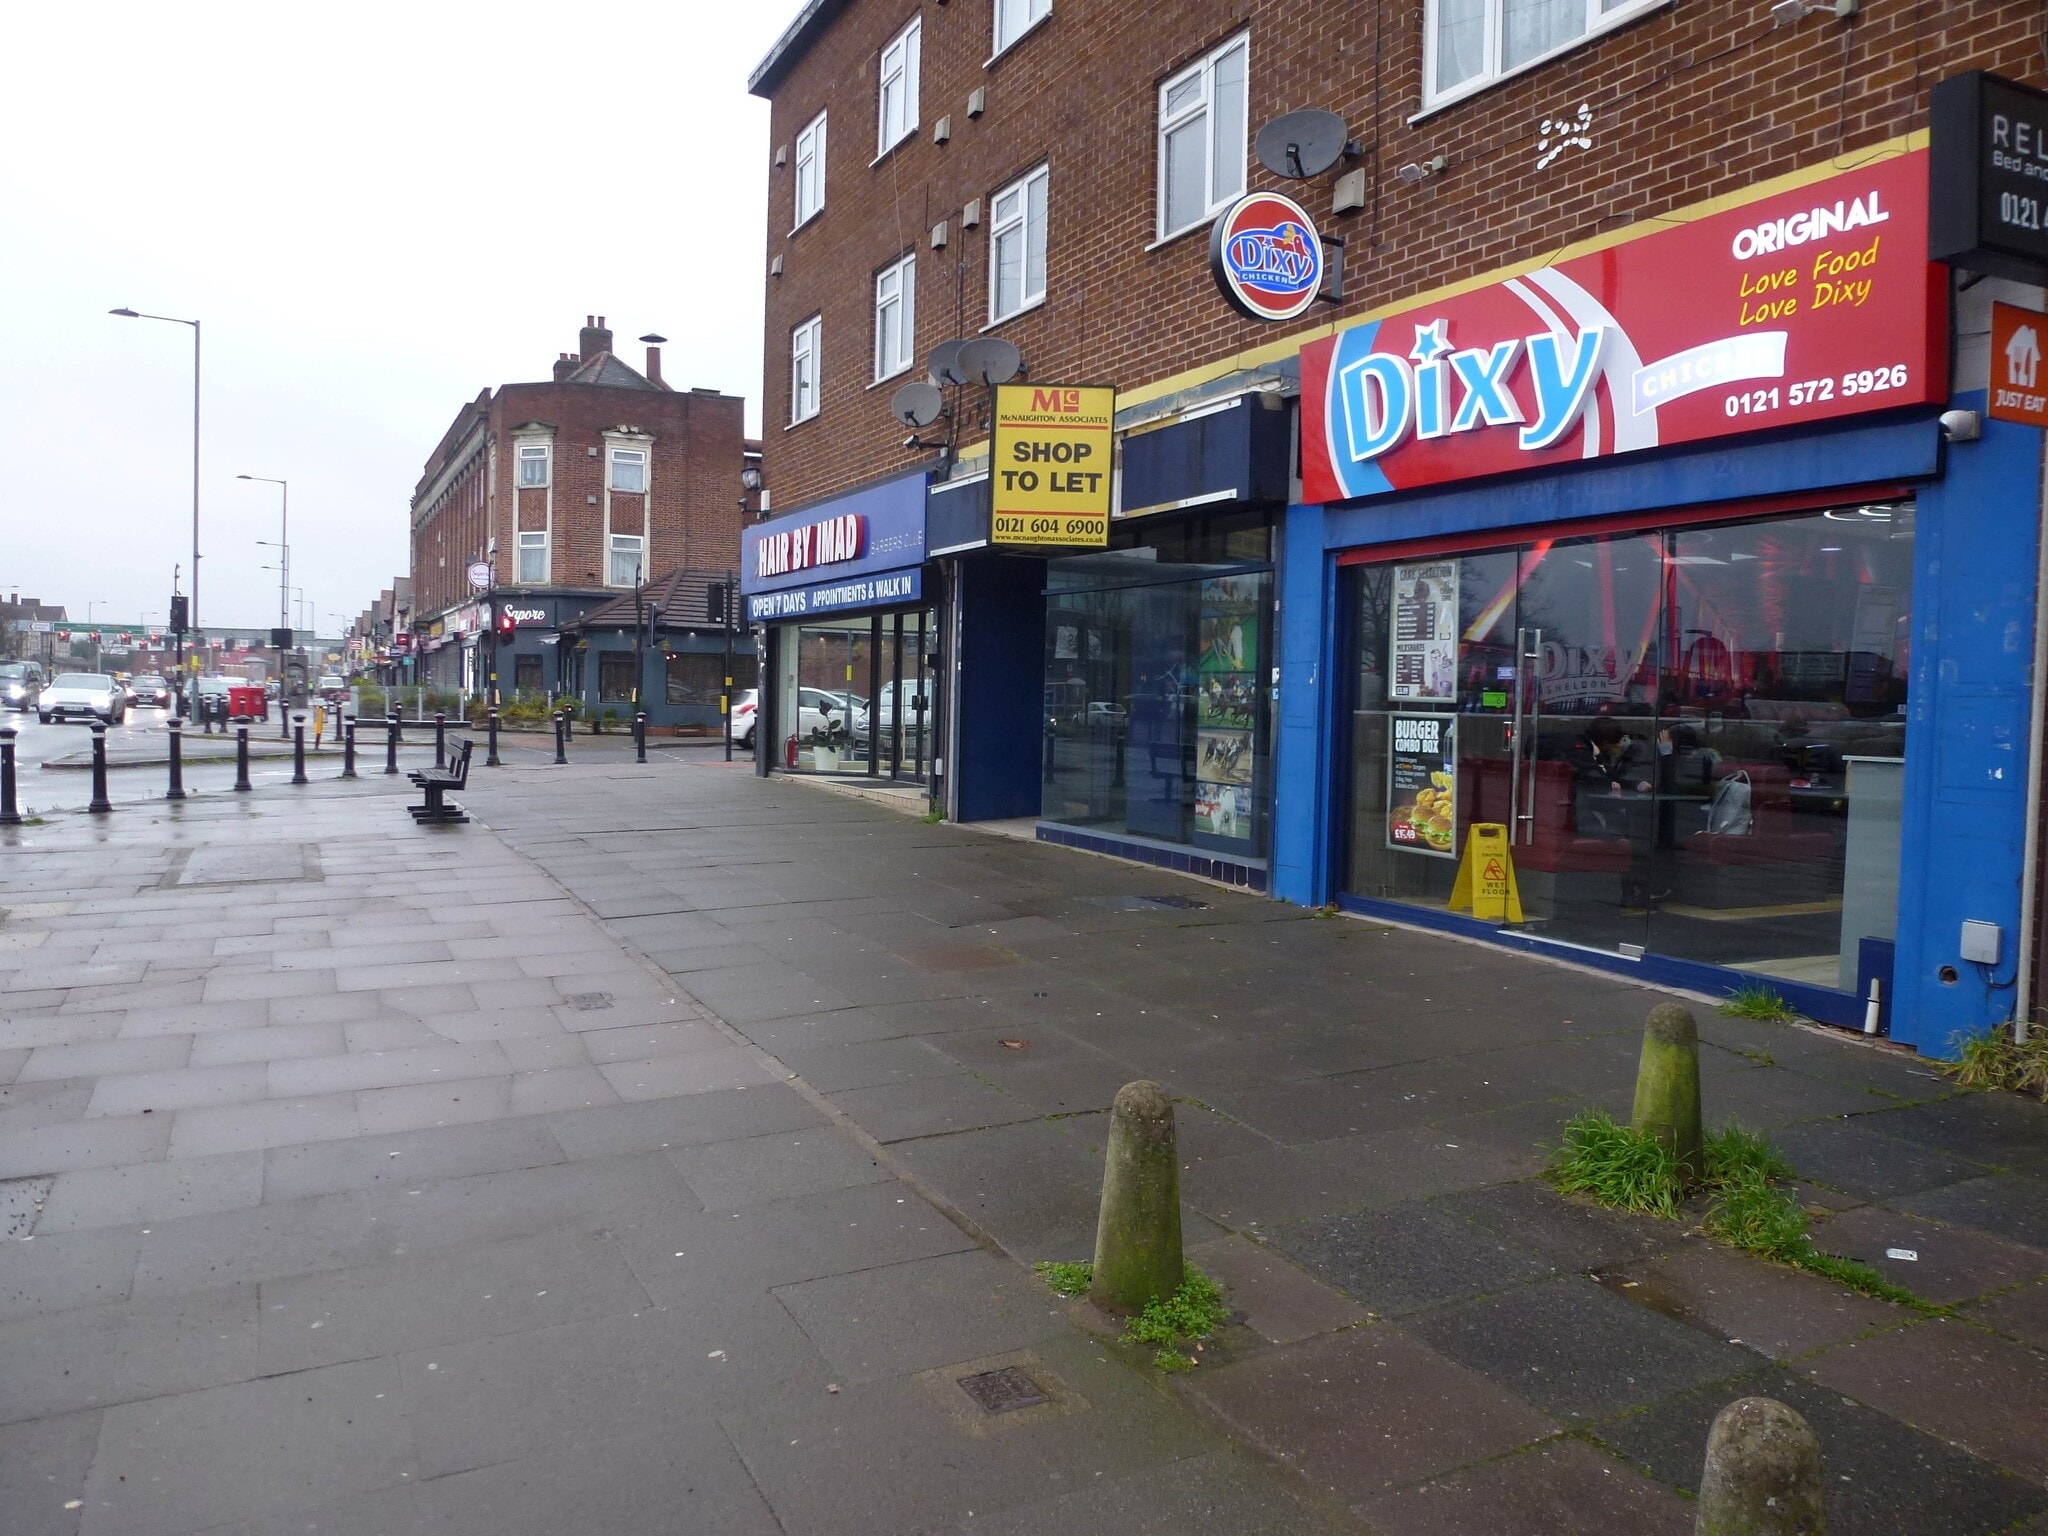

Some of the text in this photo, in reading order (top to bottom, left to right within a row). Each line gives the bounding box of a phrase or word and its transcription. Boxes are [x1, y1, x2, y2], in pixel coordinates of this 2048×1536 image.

[1993, 150, 2022, 172] Bed
[2001, 192, 2040, 230] 0121
[1732, 190, 1889, 260] ORIGINAL
[1740, 236, 1880, 297] Love Food
[1242, 273, 1289, 283] CHICKEN
[1740, 279, 1872, 325] Love Dixy
[1339, 319, 1613, 463] Dixy
[1725, 364, 1908, 417] 0121 572 5926
[1995, 389, 2046, 413] JUST EAT
[1058, 415, 1108, 423] ASSOCIATES
[1013, 441, 1092, 463] SHOP
[1001, 471, 1102, 493] TO LET
[996, 518, 1104, 535] 0121 604 6900
[759, 514, 858, 577] HAIR BY IMAD
[995, 535, 1104, 544] www.mcnaughtonassociates.co.uk
[812, 576, 912, 608] APPOINTMENTS & WALK IN
[504, 604, 545, 625] Sapore
[753, 592, 806, 618] OPEN 7 DAYS
[1546, 680, 1608, 694] SHELDON
[1395, 720, 1440, 740] BURGER
[1395, 739, 1440, 753] COMBO BOX
